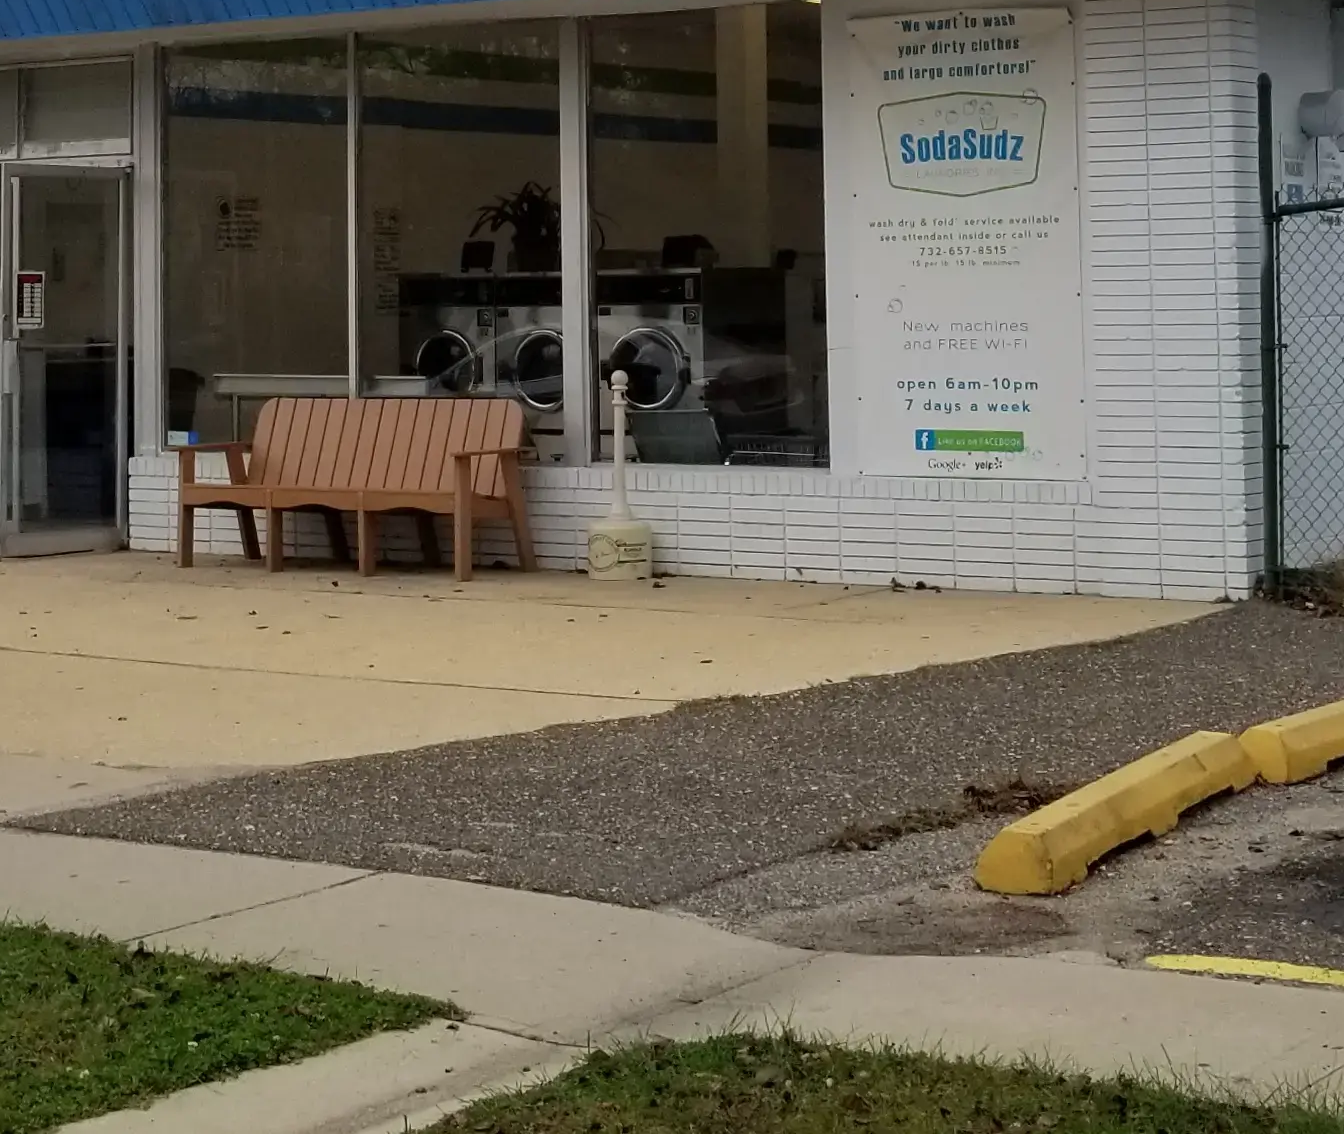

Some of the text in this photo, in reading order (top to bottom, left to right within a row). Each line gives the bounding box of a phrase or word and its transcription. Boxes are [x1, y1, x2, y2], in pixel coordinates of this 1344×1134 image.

[926, 17, 958, 30] want
[964, 16, 977, 28] to
[983, 14, 1016, 27] wash
[898, 37, 1019, 58] your dirty clothes
[883, 67, 905, 81] and
[910, 65, 943, 80] large
[900, 128, 1024, 164] SodaSudz
[869, 219, 893, 228] wash
[898, 218, 915, 229] dry
[920, 218, 927, 227] &
[964, 216, 1003, 226] service
[1009, 215, 1060, 224] available
[902, 232, 953, 241] attendant
[958, 231, 990, 240] inside
[1012, 230, 1031, 239] call
[1037, 231, 1049, 239] us
[919, 245, 1007, 256] 732-657-8515
[903, 320, 1029, 332] New machines
[904, 340, 931, 350] and
[938, 338, 978, 350] FREE
[896, 377, 1038, 393] open 6am-10pm
[904, 398, 1031, 414] 7 days a week
